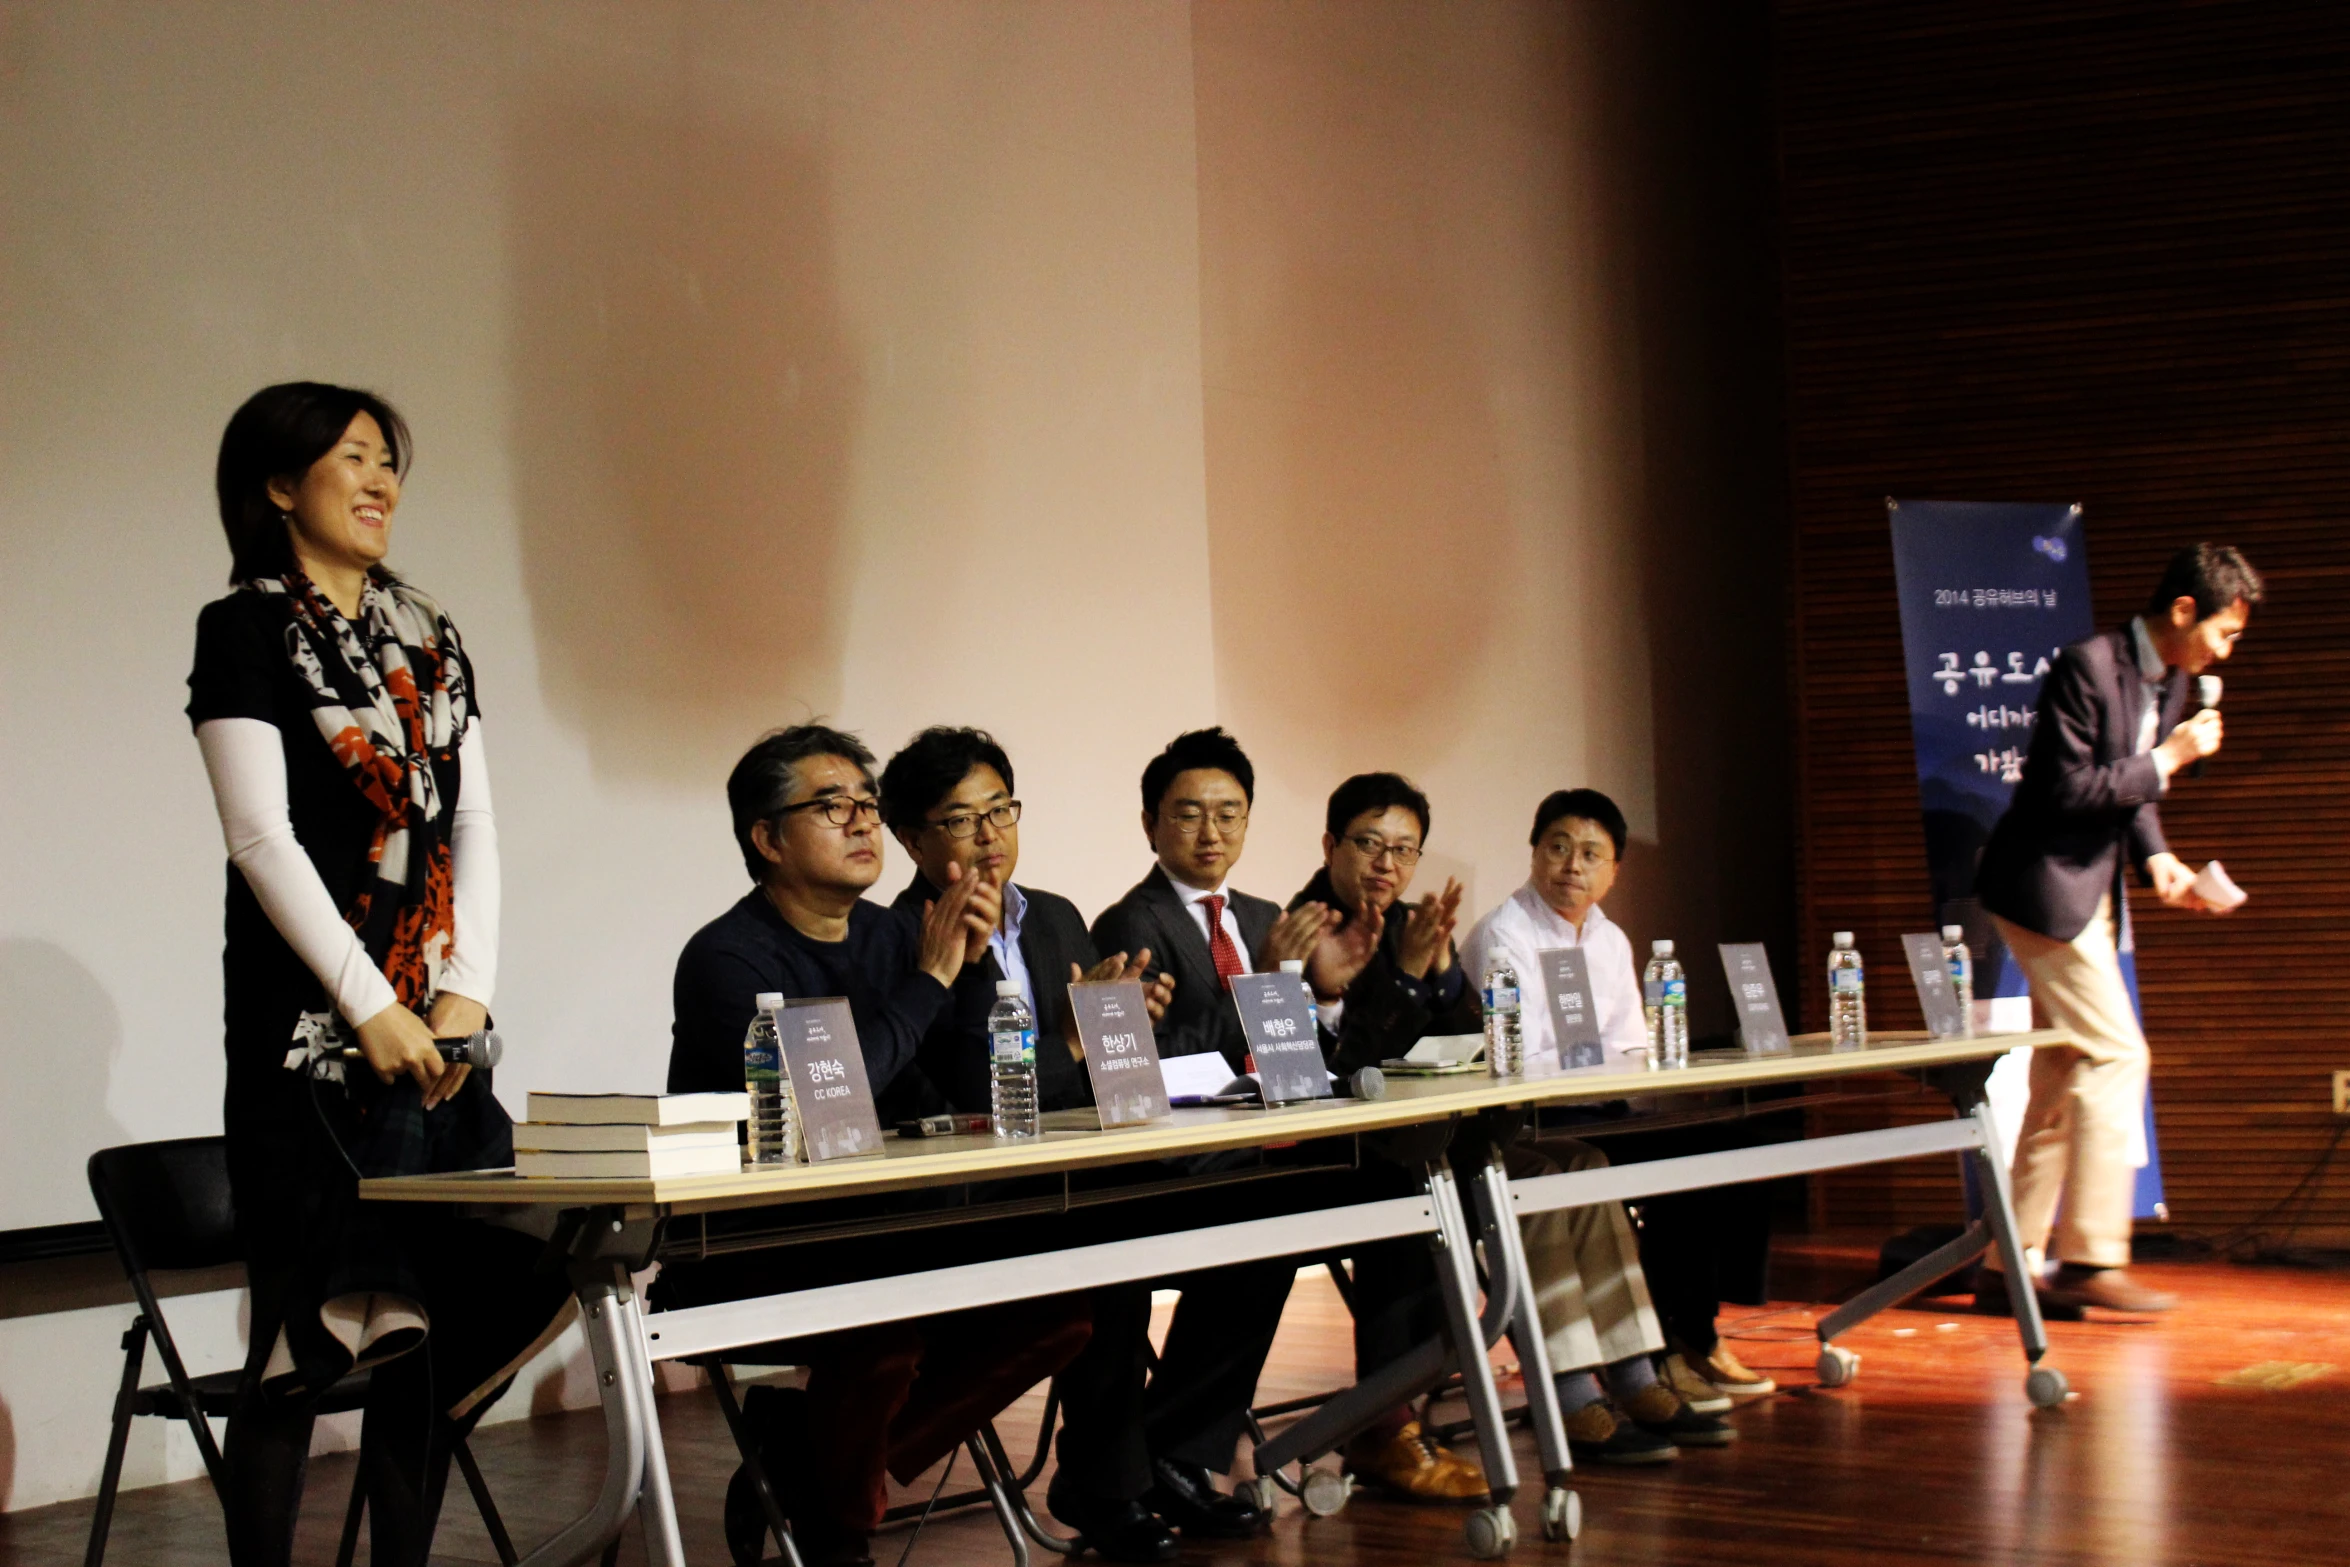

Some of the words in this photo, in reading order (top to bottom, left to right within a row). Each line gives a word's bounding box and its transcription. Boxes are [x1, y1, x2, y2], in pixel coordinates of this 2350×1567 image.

[1935, 589, 1969, 605] 2014
[1972, 589, 2039, 608] 공유허브의
[2042, 590, 2058, 607] 날
[1966, 705, 2039, 730] 어디까
[1974, 745, 2028, 783] 가봤
[1262, 1018, 1296, 1037] 배형우
[1101, 1032, 1137, 1054] 한상기
[807, 1058, 845, 1084] 강현숙
[1130, 1056, 1151, 1068] 연구소
[814, 1088, 826, 1100] CC
[826, 1084, 851, 1098] KOREA
